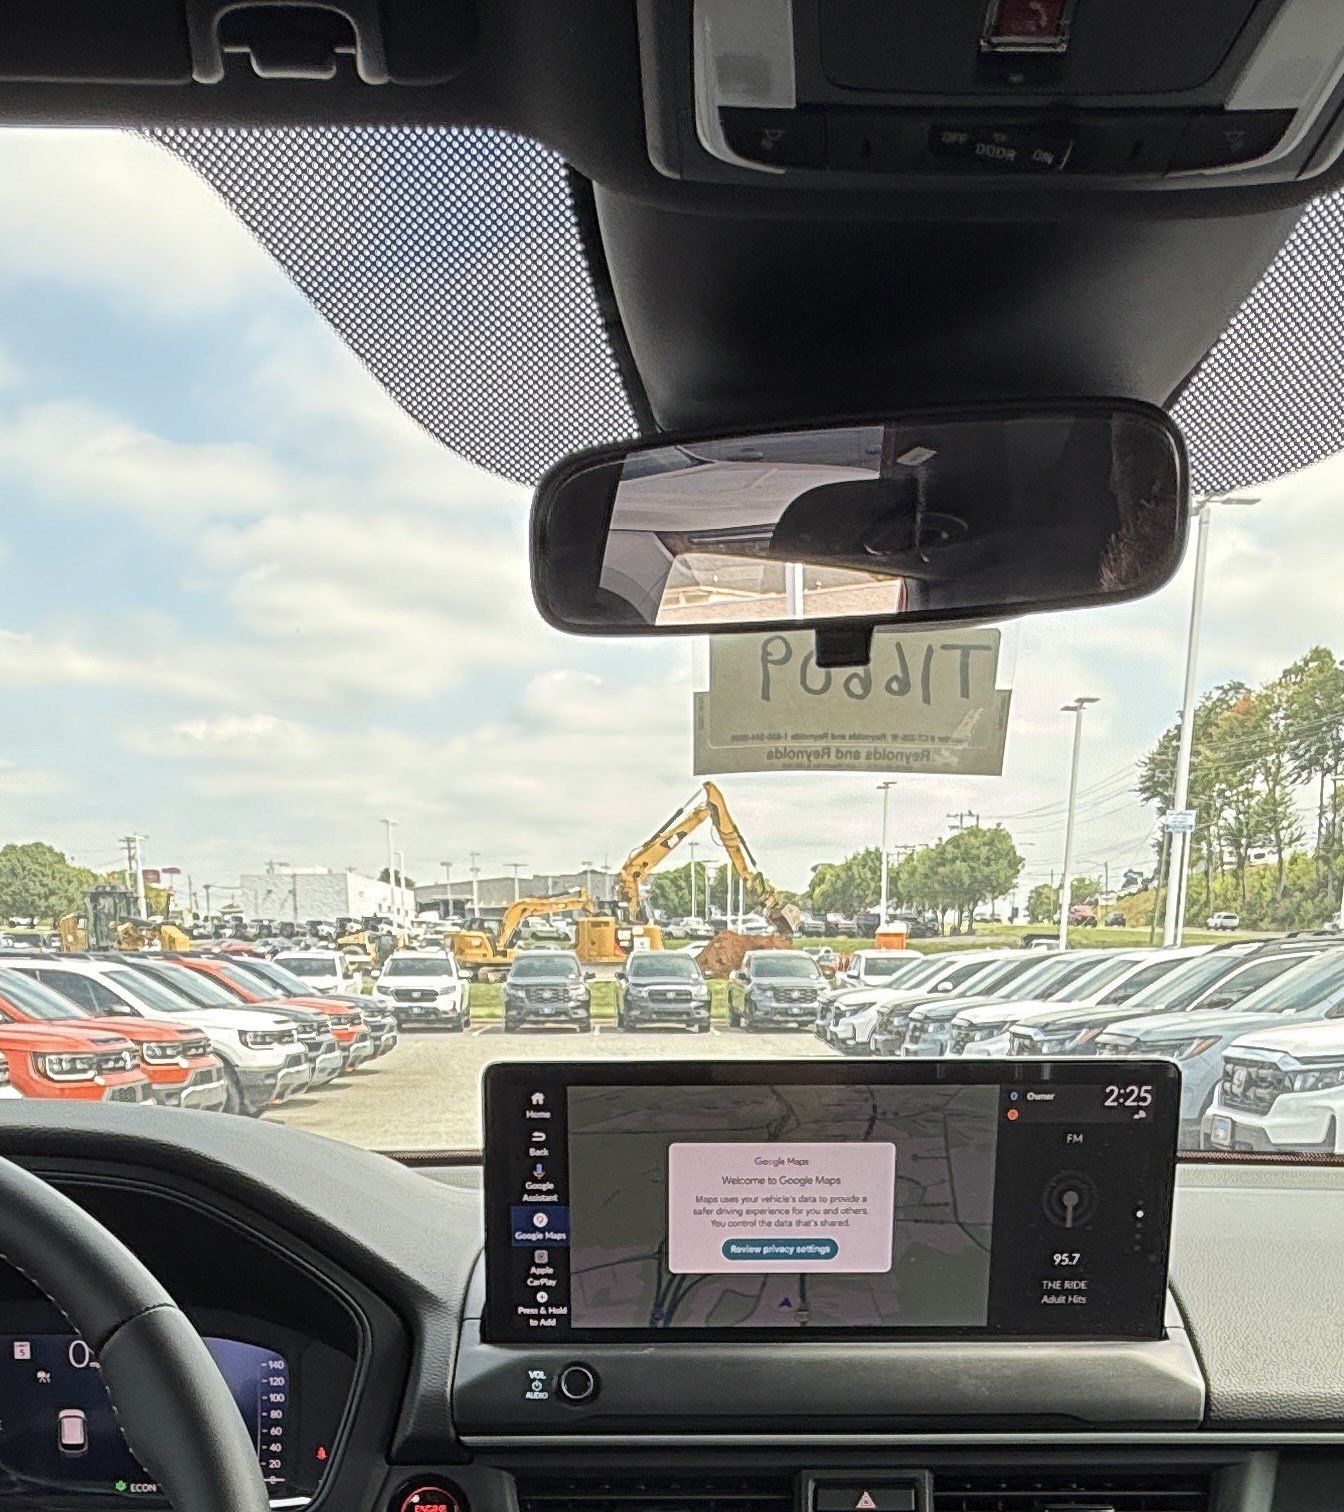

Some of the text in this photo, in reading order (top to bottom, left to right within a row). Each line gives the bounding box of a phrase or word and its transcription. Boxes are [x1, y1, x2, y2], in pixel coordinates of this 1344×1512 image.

[1104, 1085, 1152, 1107] 2:25
[1066, 1134, 1083, 1143] FM
[754, 1156, 809, 1167] Google Maps
[721, 1175, 842, 1187] Welcome to Google Maps
[710, 1219, 726, 1228] You
[727, 1219, 757, 1228] control
[758, 1219, 773, 1228] the
[773, 1219, 793, 1228] data
[514, 1231, 567, 1241] Google Maps
[762, 1244, 795, 1256] privacy
[795, 1244, 832, 1256] settings
[1053, 1252, 1081, 1266] 95.7
[1042, 1280, 1088, 1290] THE RIDE
[69, 1340, 89, 1368] 0
[528, 1370, 547, 1380] VOL
[268, 1376, 286, 1386] 120
[269, 1409, 283, 1419] 80
[270, 1426, 283, 1436] 60
[269, 1443, 282, 1452] 40
[268, 1460, 281, 1469] 20
[130, 1484, 157, 1492] ECON
